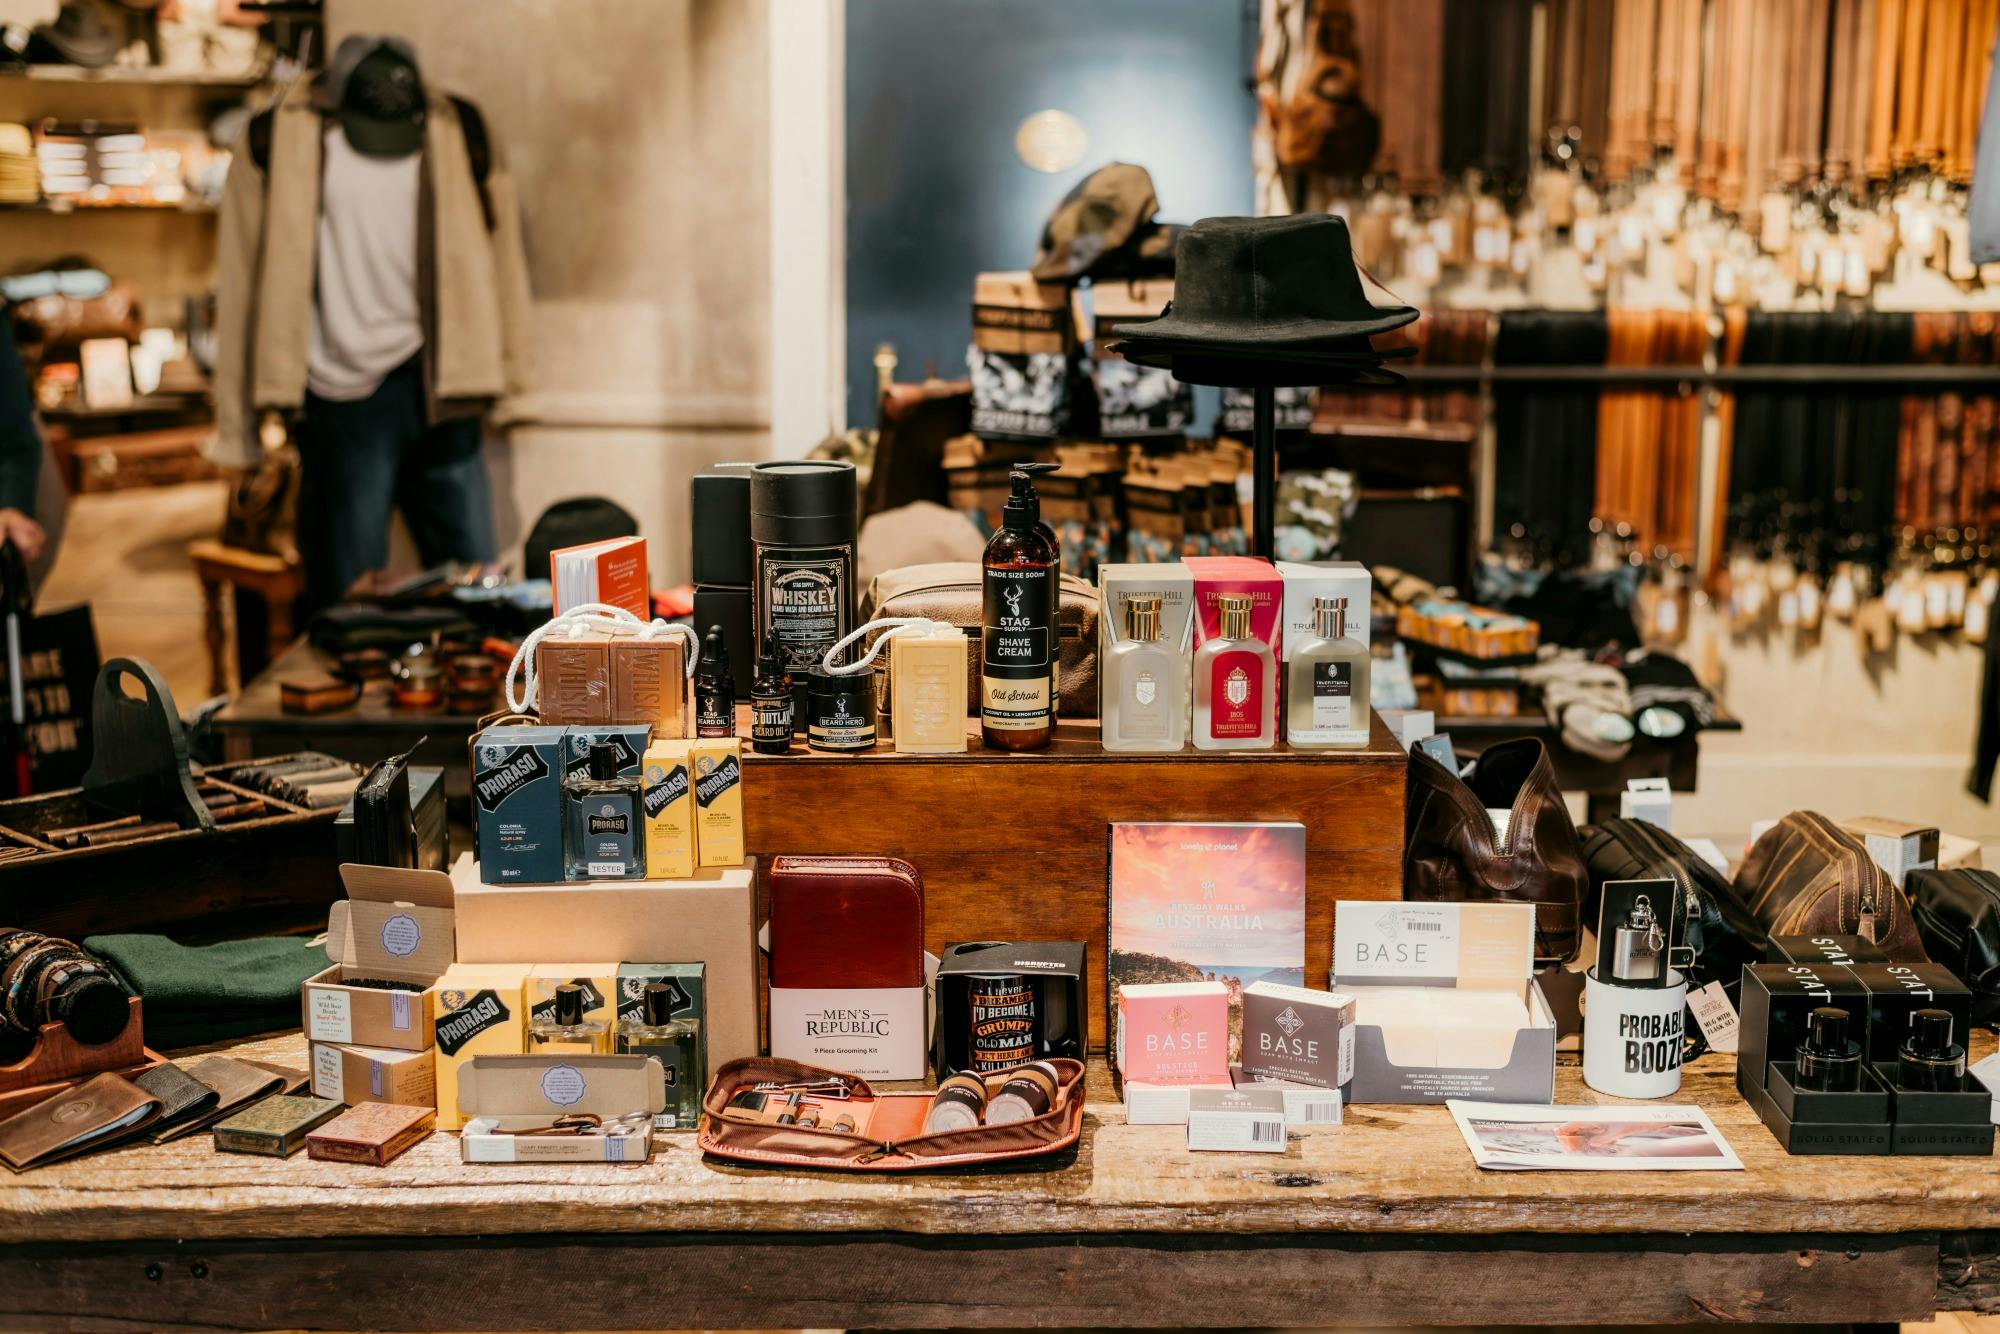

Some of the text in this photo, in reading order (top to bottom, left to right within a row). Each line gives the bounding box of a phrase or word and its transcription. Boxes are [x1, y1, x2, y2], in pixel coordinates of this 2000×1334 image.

[987, 571, 1006, 579] TRADE
[772, 587, 837, 605] WHISKEY
[1164, 591, 1184, 600] HILL
[1252, 592, 1272, 600] HILL
[1000, 617, 1030, 627] STAG
[999, 638, 1031, 647] SHAVE
[998, 647, 1032, 657] CREAM
[560, 653, 587, 726] WHISK
[991, 689, 1040, 703] Old School
[755, 727, 785, 737] BEARD OIL
[477, 753, 538, 801] PRORASO
[696, 762, 739, 801] PRORASO
[504, 780, 526, 794] FIRENZE
[645, 772, 688, 811] PRORASO
[592, 819, 625, 830] PRORASO
[1214, 843, 1237, 851] planet
[1154, 913, 1262, 930] AUSTRALIA
[1356, 943, 1428, 963] BASE
[995, 985, 1024, 996] never
[979, 992, 1030, 1005] DREAMED
[824, 1009, 870, 1020] MEN'S
[973, 1001, 1035, 1023] I'D BECOME A
[437, 996, 500, 1046] PRORASO
[1704, 1011, 1731, 1029] MUG WITH
[464, 1023, 486, 1039] FIRENZE
[806, 1019, 890, 1037] REPUBLIC
[977, 1019, 1032, 1036] GRUMPY
[1707, 1019, 1736, 1036] FLASK SET
[976, 1033, 1033, 1048] OLD MAN
[1147, 1032, 1208, 1052] BASE
[1260, 1032, 1318, 1058] BASE
[981, 1052, 995, 1060] BUT
[997, 1051, 1016, 1059] HERE
[1295, 1057, 1319, 1065] IMPACT
[1269, 1065, 1310, 1077] SPECIAL EDITION
[1797, 1135, 1834, 1145] SOLID
[1899, 1135, 1936, 1145] SOLID
